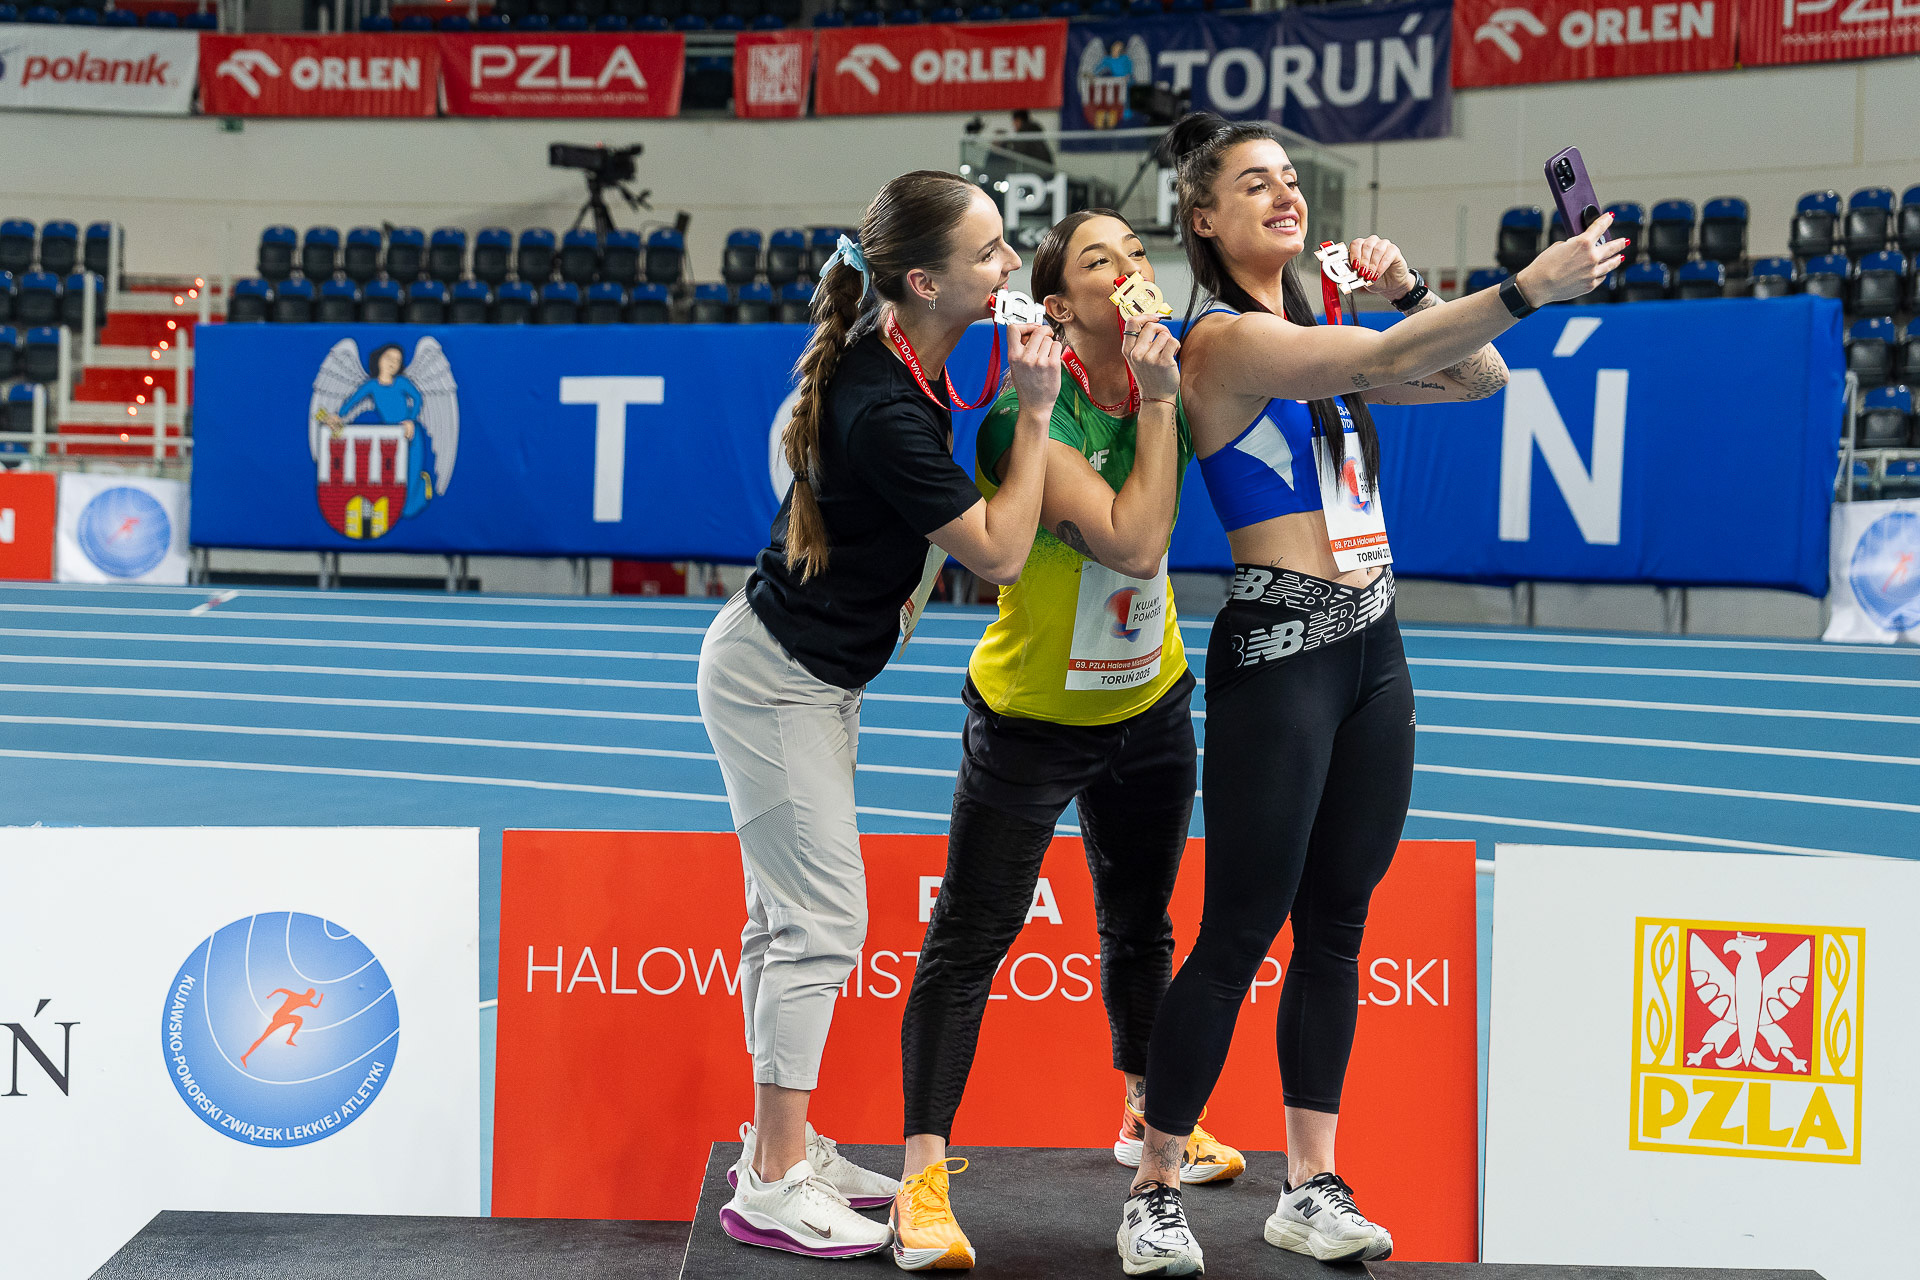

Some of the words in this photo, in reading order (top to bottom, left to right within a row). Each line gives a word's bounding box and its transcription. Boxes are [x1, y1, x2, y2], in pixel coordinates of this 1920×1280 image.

[1559, 2, 1714, 49] ORLEN
[20, 49, 171, 87] polanik
[290, 56, 421, 91] ORLEN
[470, 44, 648, 89] PZLA
[910, 44, 1046, 84] ORLEN
[1157, 12, 1434, 113] TORUŃ
[1004, 172, 1068, 230] P1
[892, 328, 915, 361] POLSKI
[1356, 547, 1383, 562] TORUŃ
[1075, 661, 1088, 669] 69.
[1101, 670, 1135, 685] TORUŃ
[918, 875, 1063, 925] PA
[526, 945, 742, 996] HALOW
[1250, 956, 1449, 1007] PSKI
[169, 973, 223, 1121] KUJAWSKO-POMORSKI
[220, 1113, 283, 1142] ZWIĄZEK
[285, 1110, 342, 1141] LEKKIEJ
[341, 1060, 386, 1118] ATLETYKI
[1642, 1075, 1848, 1151] PZLA
